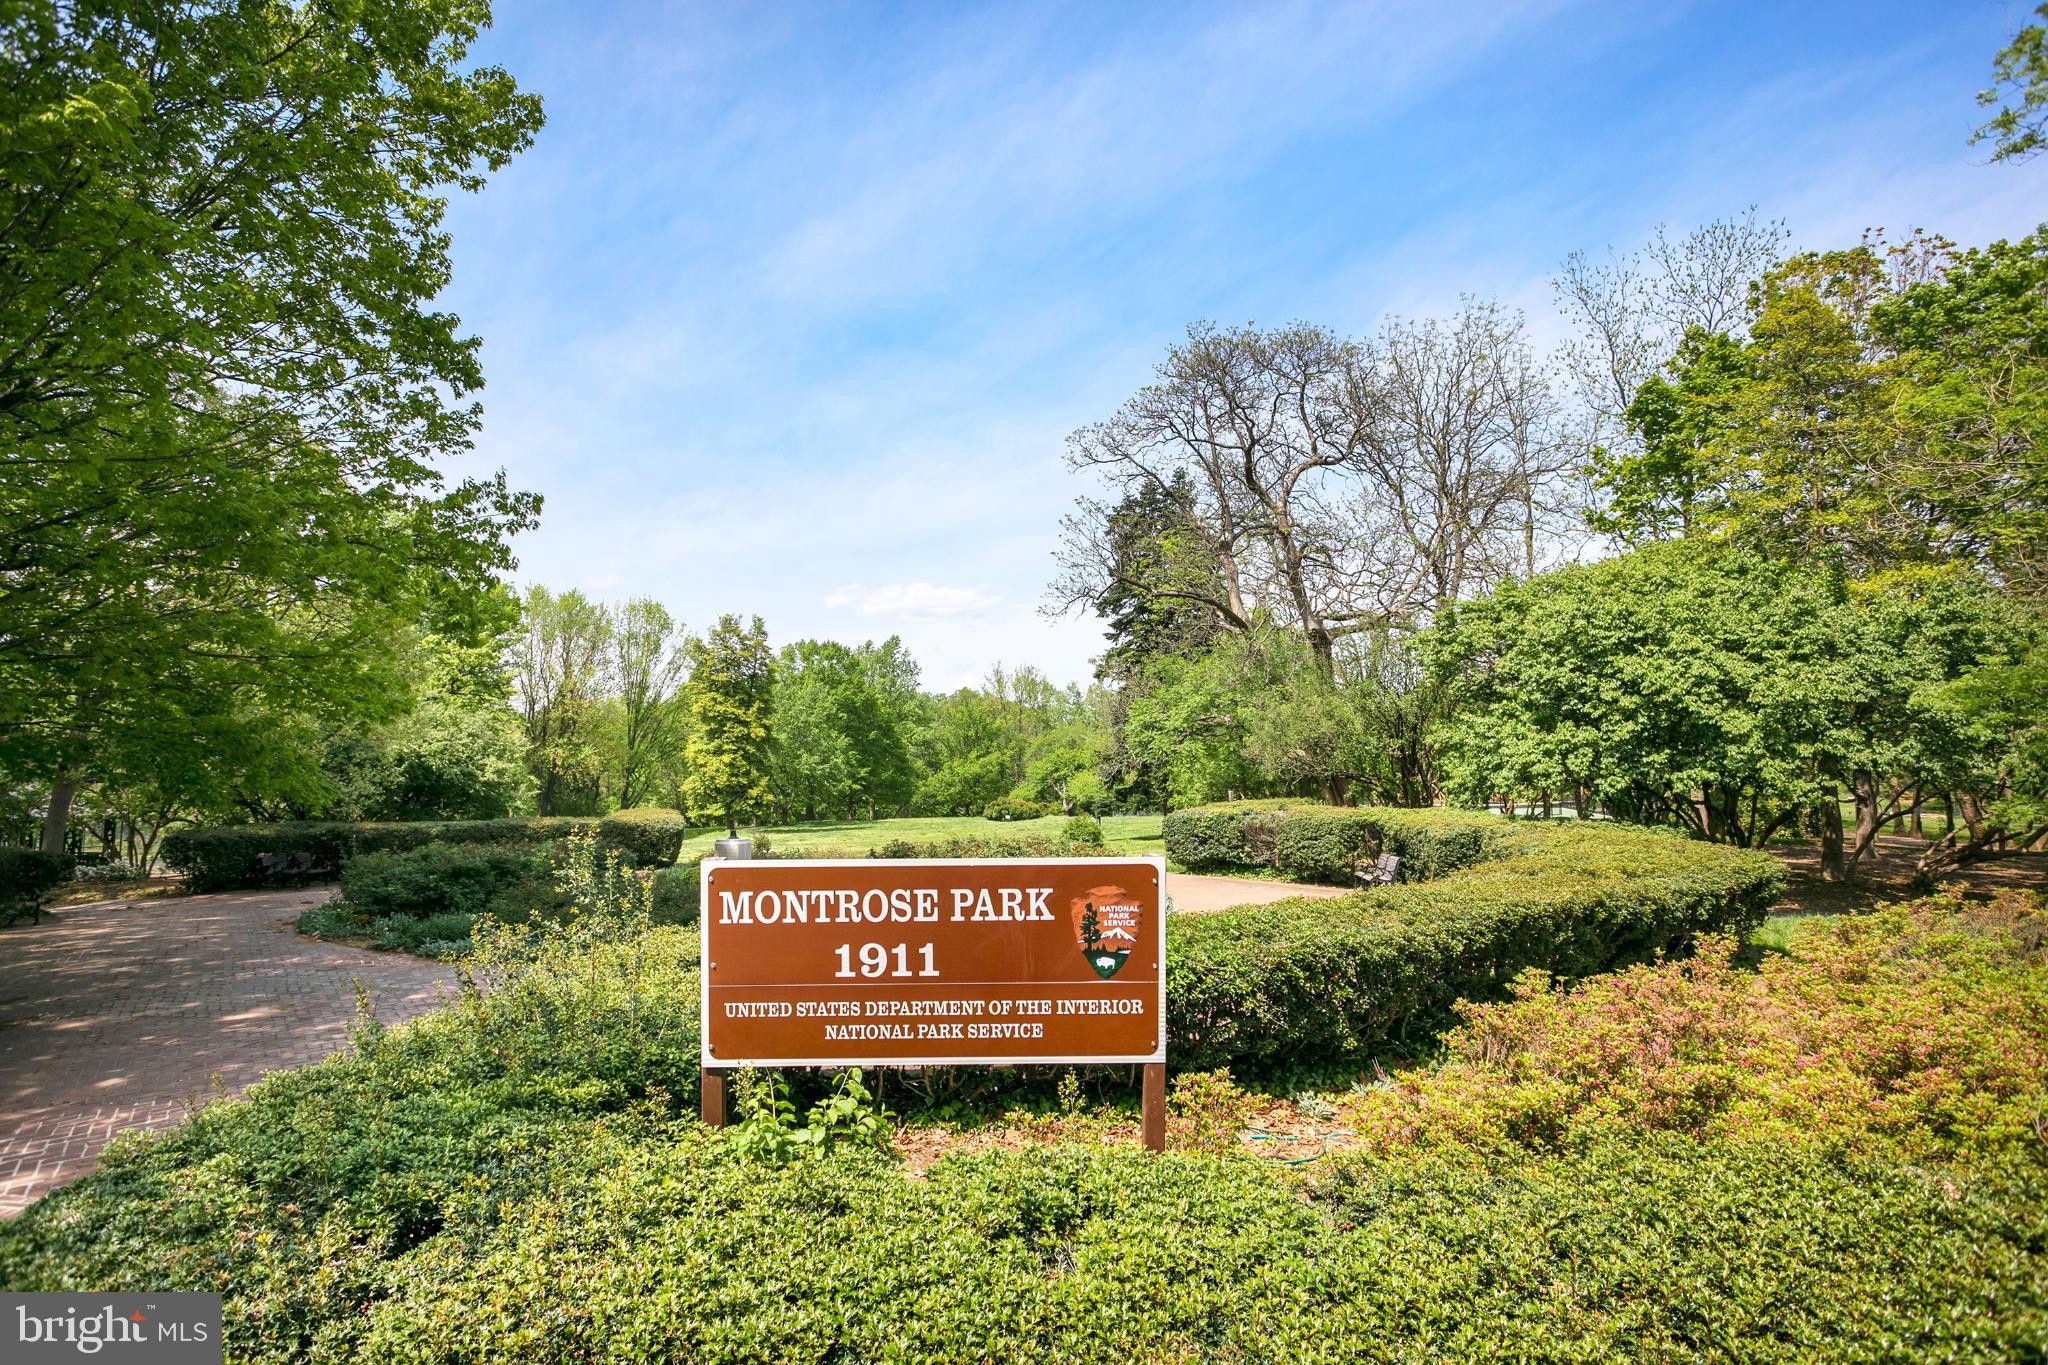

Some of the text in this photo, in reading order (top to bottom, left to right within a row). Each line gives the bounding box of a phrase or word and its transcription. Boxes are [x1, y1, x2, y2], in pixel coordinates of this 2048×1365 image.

[719, 888, 1055, 924] MONTROSE PARK
[1099, 905, 1139, 913] NATIONAL
[1103, 919, 1135, 928] SERVICE
[1109, 912, 1129, 920] PARK
[835, 943, 939, 977] 1911
[724, 999, 1143, 1017] UNITED STATES DEPARTMENT OF THE INTERIOR
[825, 1023, 1043, 1039] NATIONAL PARK SERVICE
